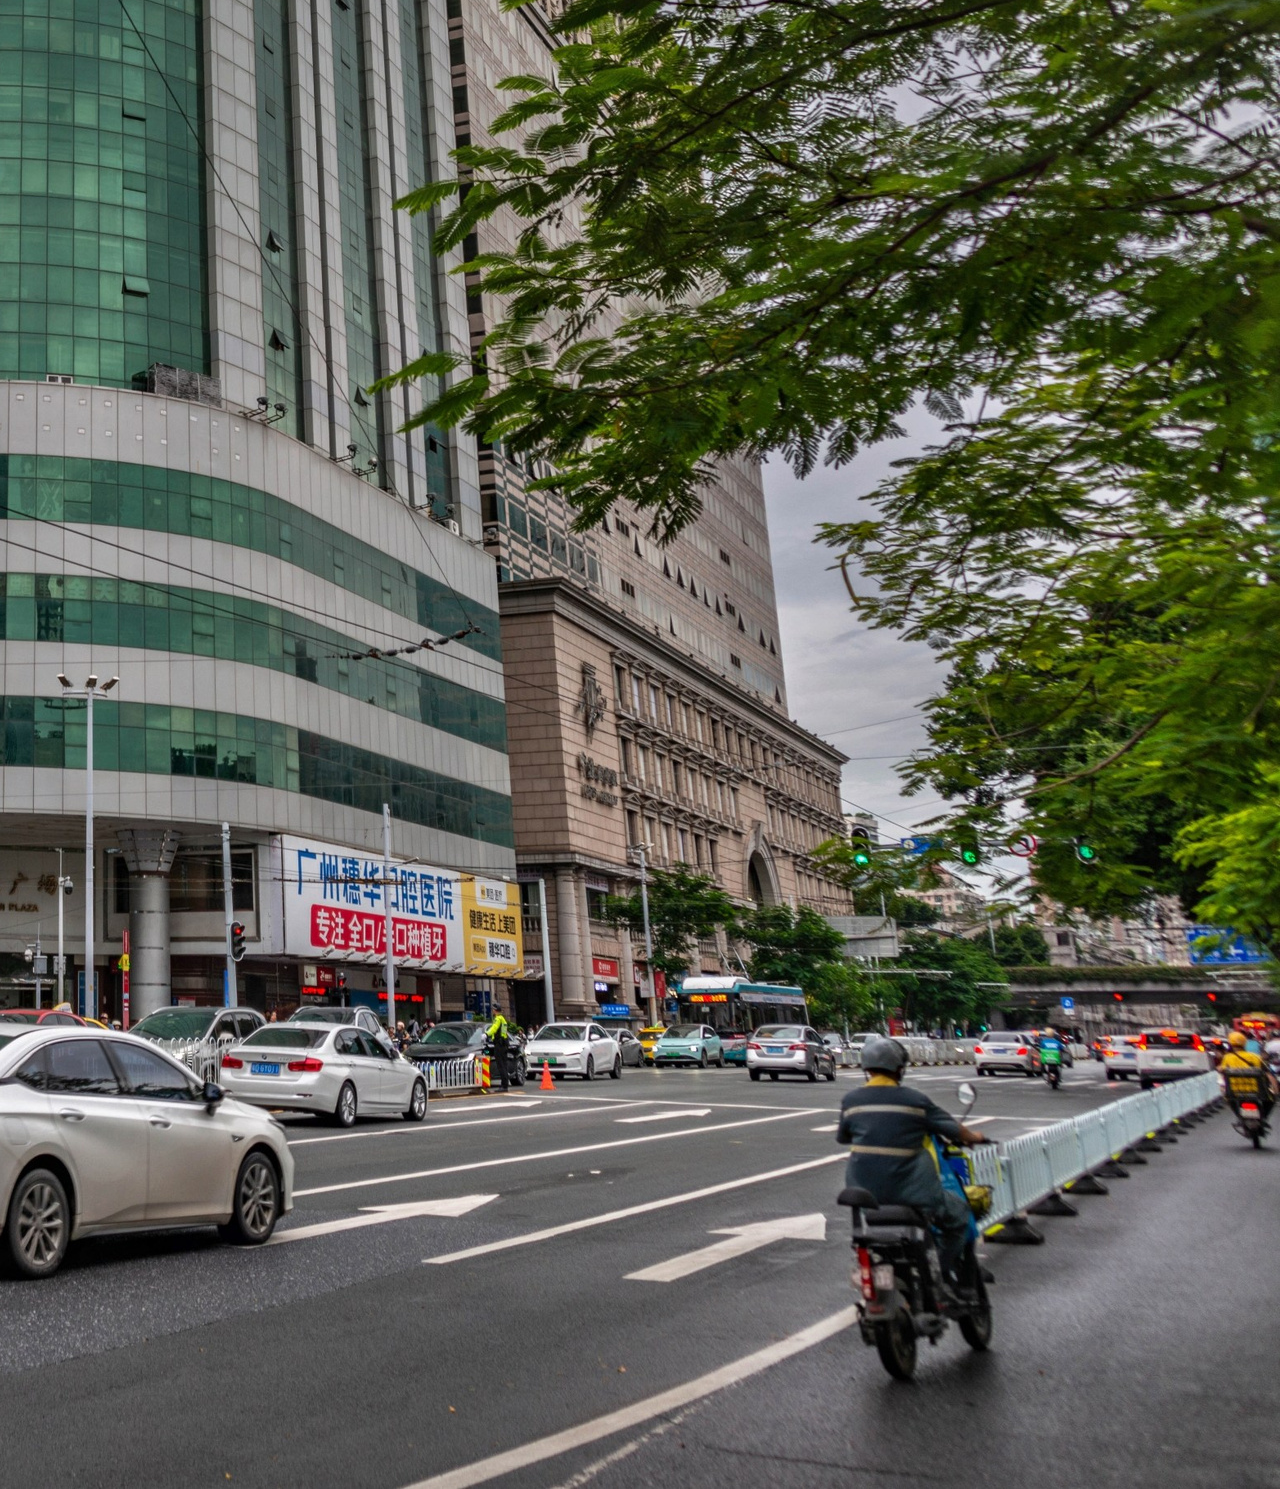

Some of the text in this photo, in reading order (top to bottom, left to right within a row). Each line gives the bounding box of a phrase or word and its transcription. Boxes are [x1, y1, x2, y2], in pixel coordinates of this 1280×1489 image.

[8, 902, 39, 912] PLAZA
[316, 908, 345, 946] 专注
[469, 908, 517, 936] 健康生活 上美团
